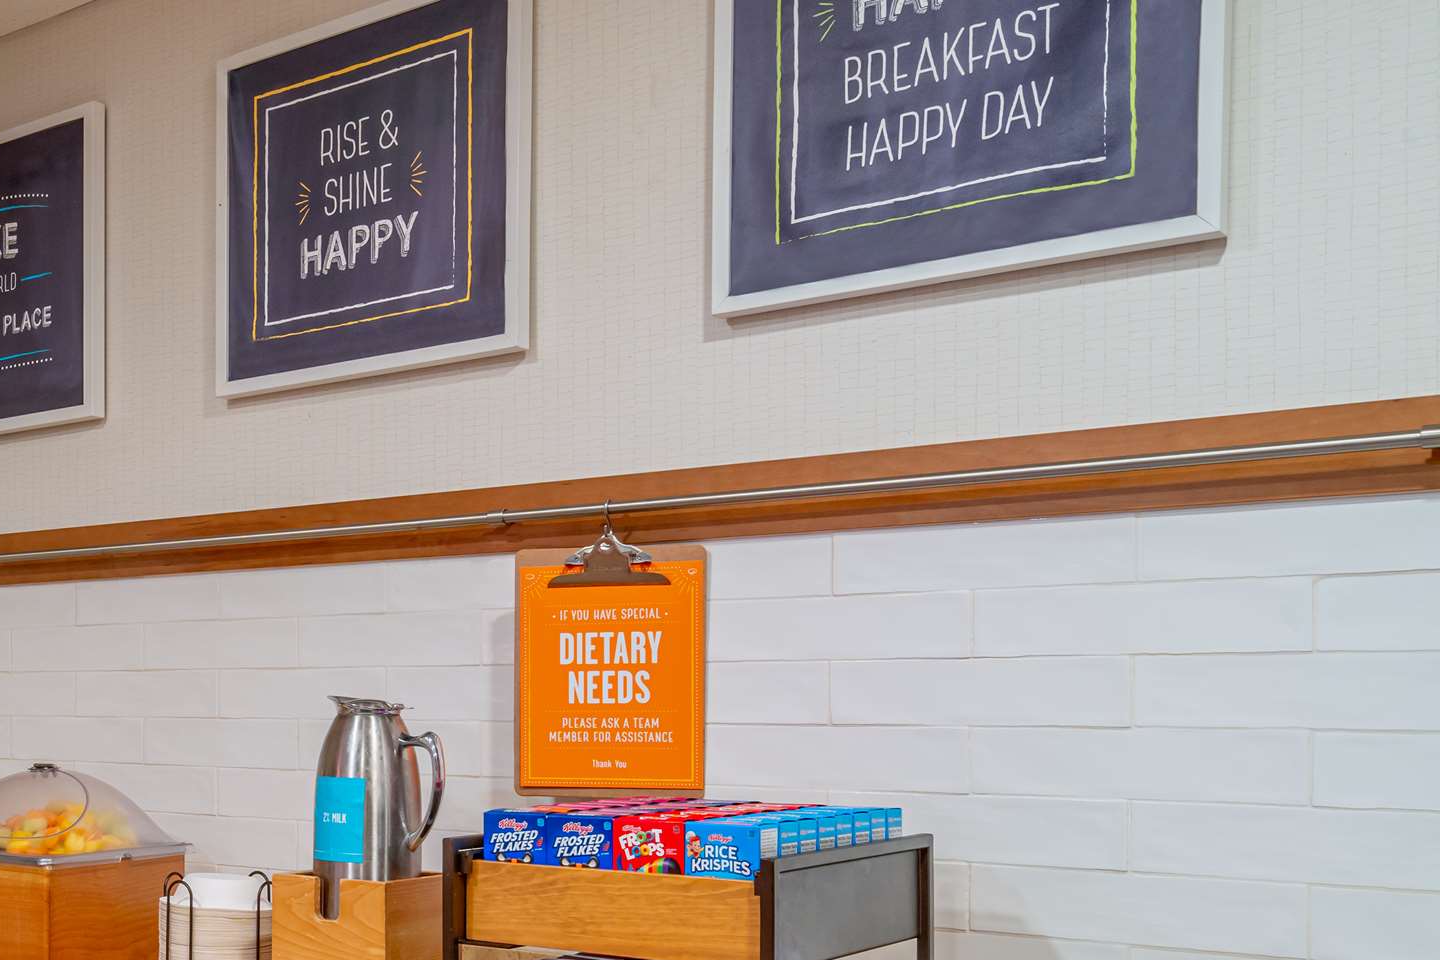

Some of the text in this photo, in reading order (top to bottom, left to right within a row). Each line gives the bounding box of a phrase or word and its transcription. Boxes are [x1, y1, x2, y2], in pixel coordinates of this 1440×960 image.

[844, 3, 1060, 105] BREAKFAST
[845, 76, 1054, 172] HAPPY DAY
[320, 109, 399, 167] RISE &
[323, 163, 393, 217] SHINE
[300, 211, 419, 280] HAPPY
[3, 305, 53, 337] PLACE
[560, 607, 662, 621] IF YOU HAVE SPECIAL
[559, 631, 663, 665] DIETARY
[568, 670, 651, 704] NEEDS
[562, 717, 660, 729] PLEASE ASK A TEAM
[549, 731, 673, 743] MEMBER FOR ASSISTANCE
[592, 760, 627, 769] Thank You
[332, 812, 347, 825] MILK
[490, 830, 539, 844] FROSTED
[553, 834, 605, 848] FROSTED
[618, 828, 663, 850] FROOT
[493, 840, 534, 854] FLAKES
[557, 844, 601, 858] FLAKES
[624, 843, 665, 861] LOOPS
[705, 845, 738, 860] RICE
[691, 858, 751, 876] KRISPIES
